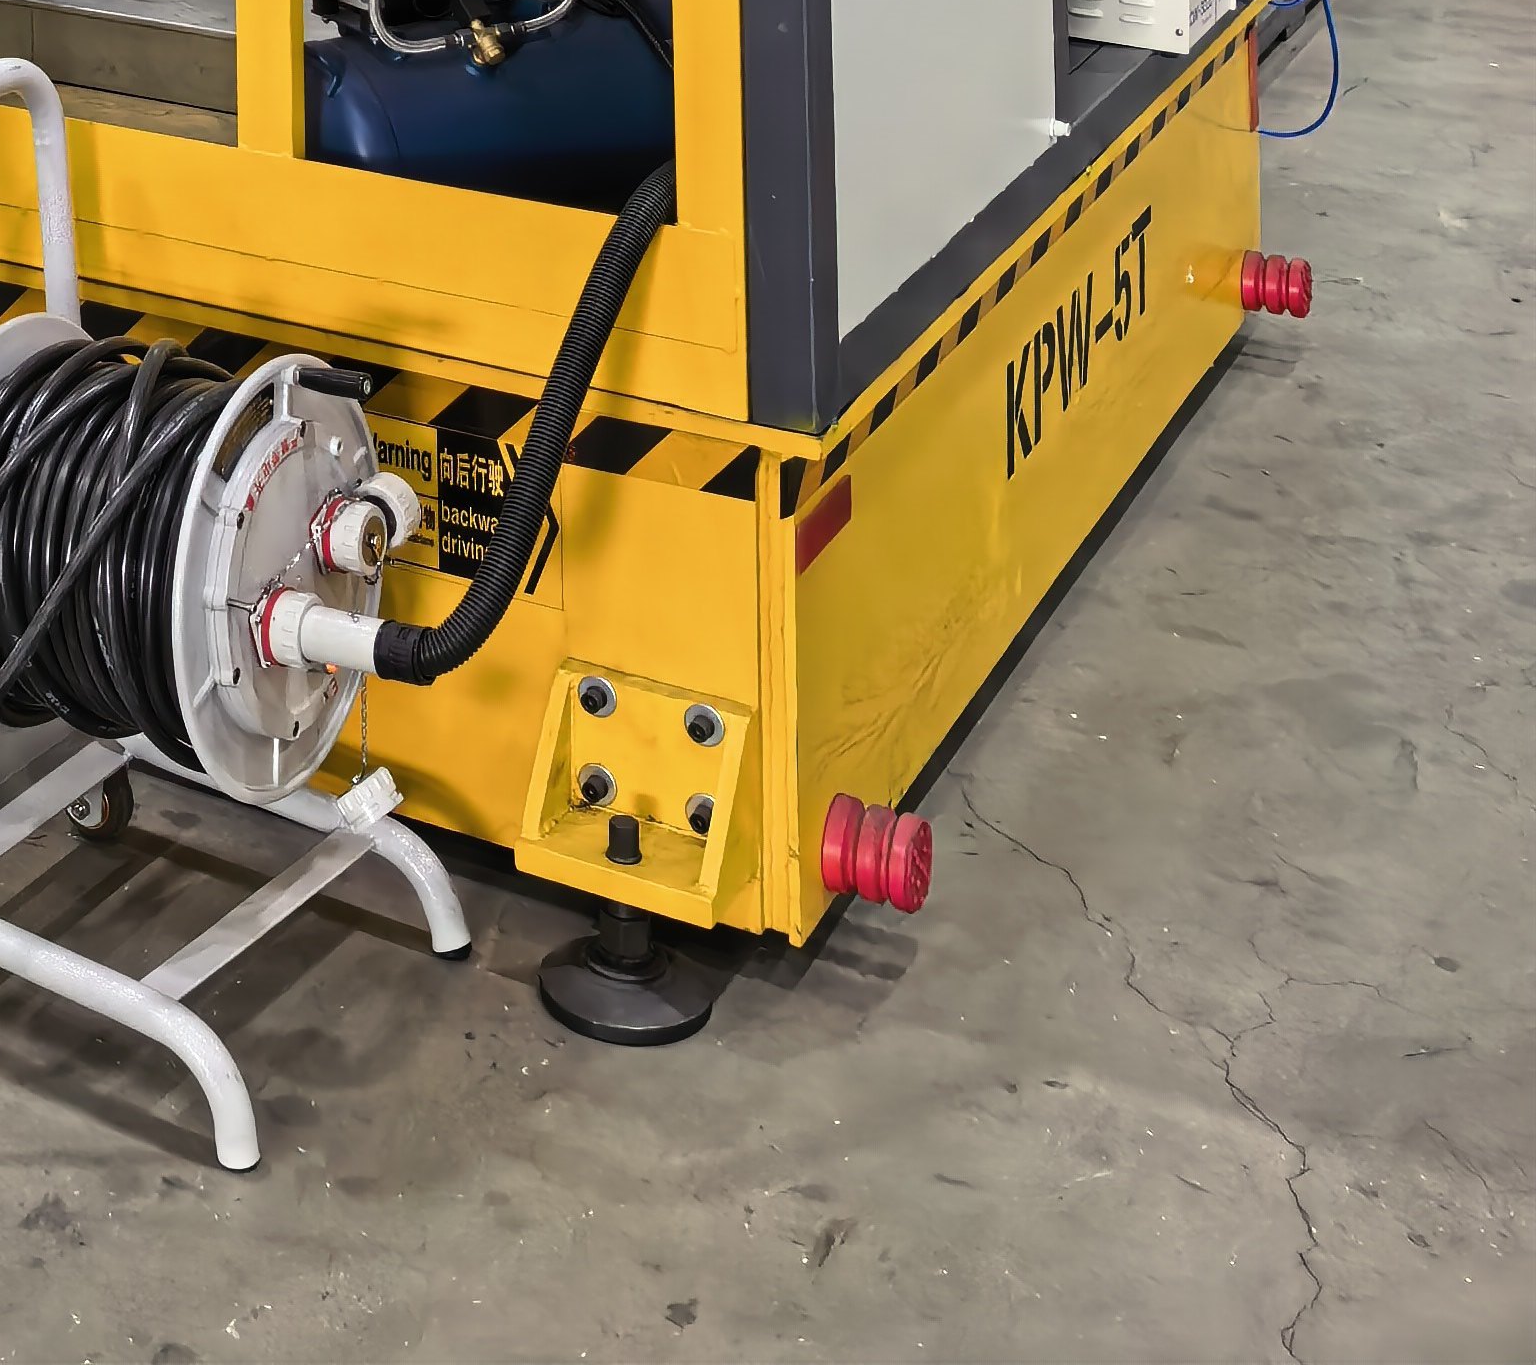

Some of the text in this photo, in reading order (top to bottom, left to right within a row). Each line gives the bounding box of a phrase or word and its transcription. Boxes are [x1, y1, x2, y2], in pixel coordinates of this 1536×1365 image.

[1006, 204, 1152, 481] KPW-5T
[373, 432, 432, 482] arning
[439, 447, 505, 498] 向后行驶
[441, 499, 500, 535] backwa
[441, 531, 489, 562] drivin
